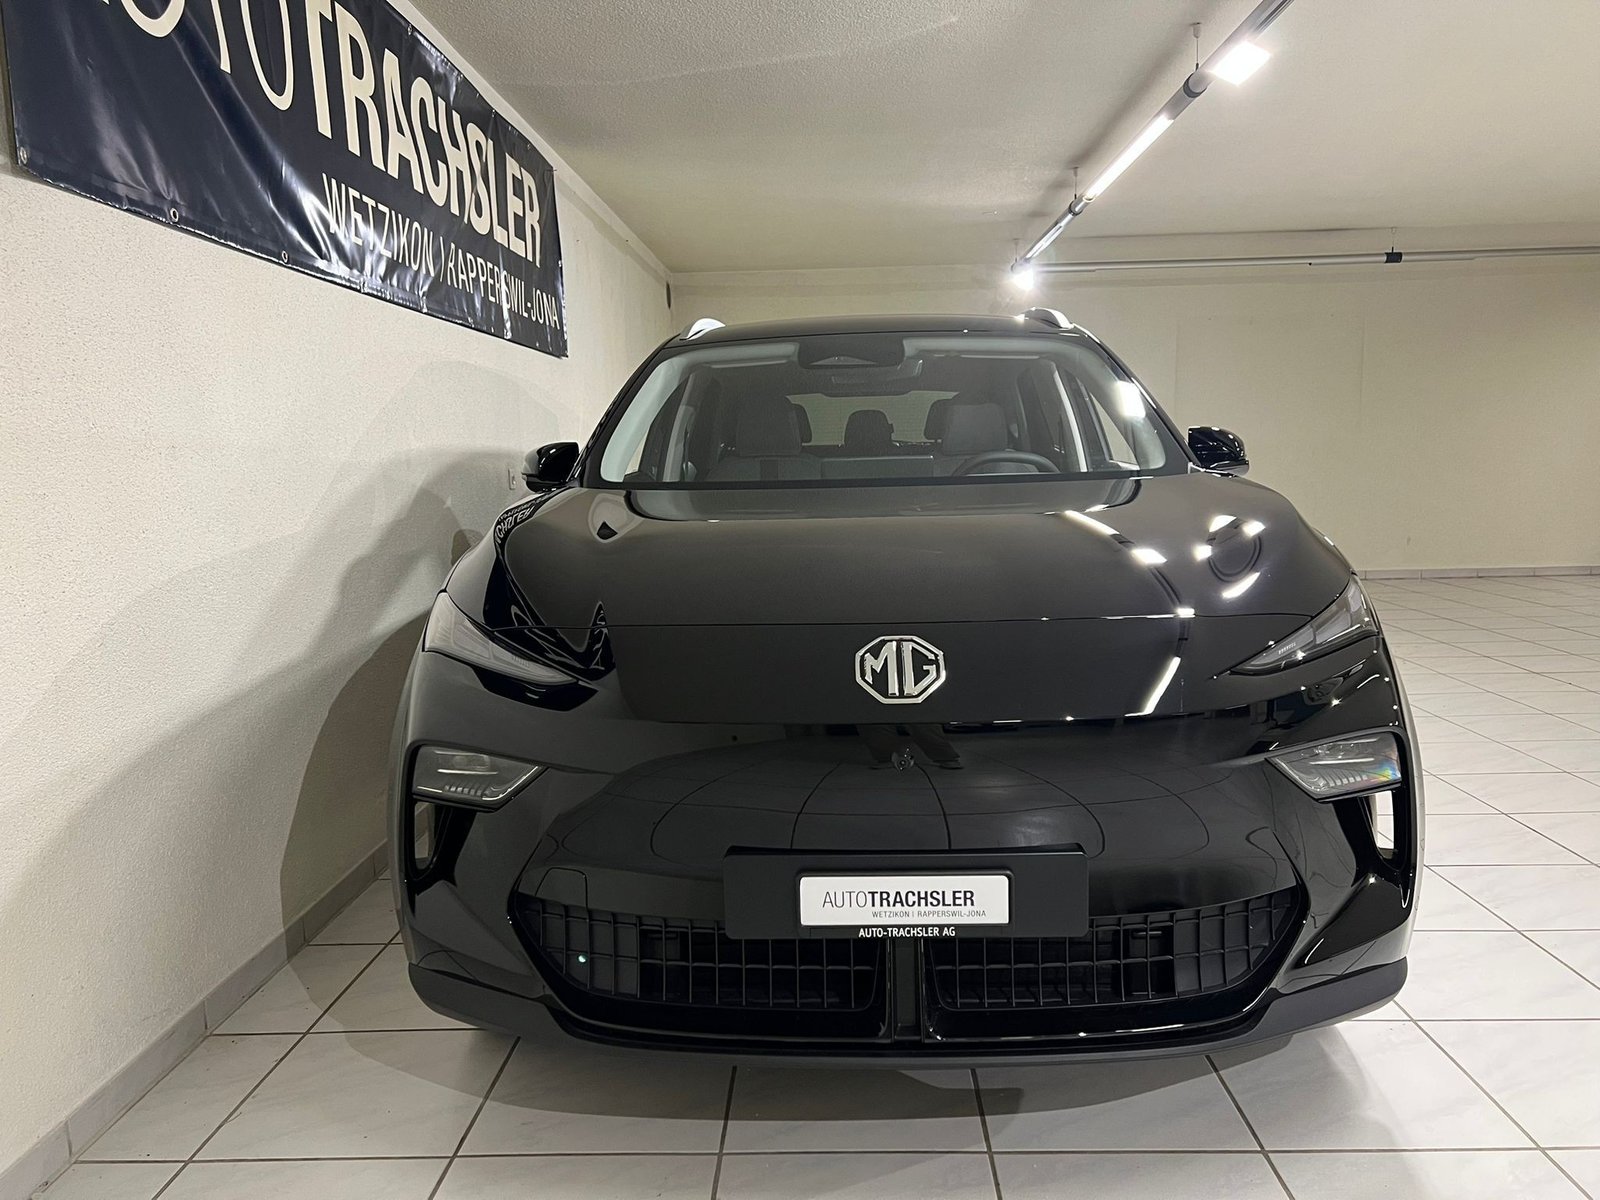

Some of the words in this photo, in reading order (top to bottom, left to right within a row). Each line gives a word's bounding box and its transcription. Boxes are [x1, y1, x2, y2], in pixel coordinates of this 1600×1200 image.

[322, 172, 435, 278] WETZIKON
[447, 242, 561, 330] RAPPERSWIL-JONA
[863, 640, 937, 697] MG
[822, 890, 976, 909] AUTOTRACHSLER
[871, 910, 910, 919] WETZIKON
[917, 909, 987, 918] RAPPERSWIL-JONA
[858, 927, 940, 938] AUTO-TRACHSLER
[942, 926, 956, 937] AG
